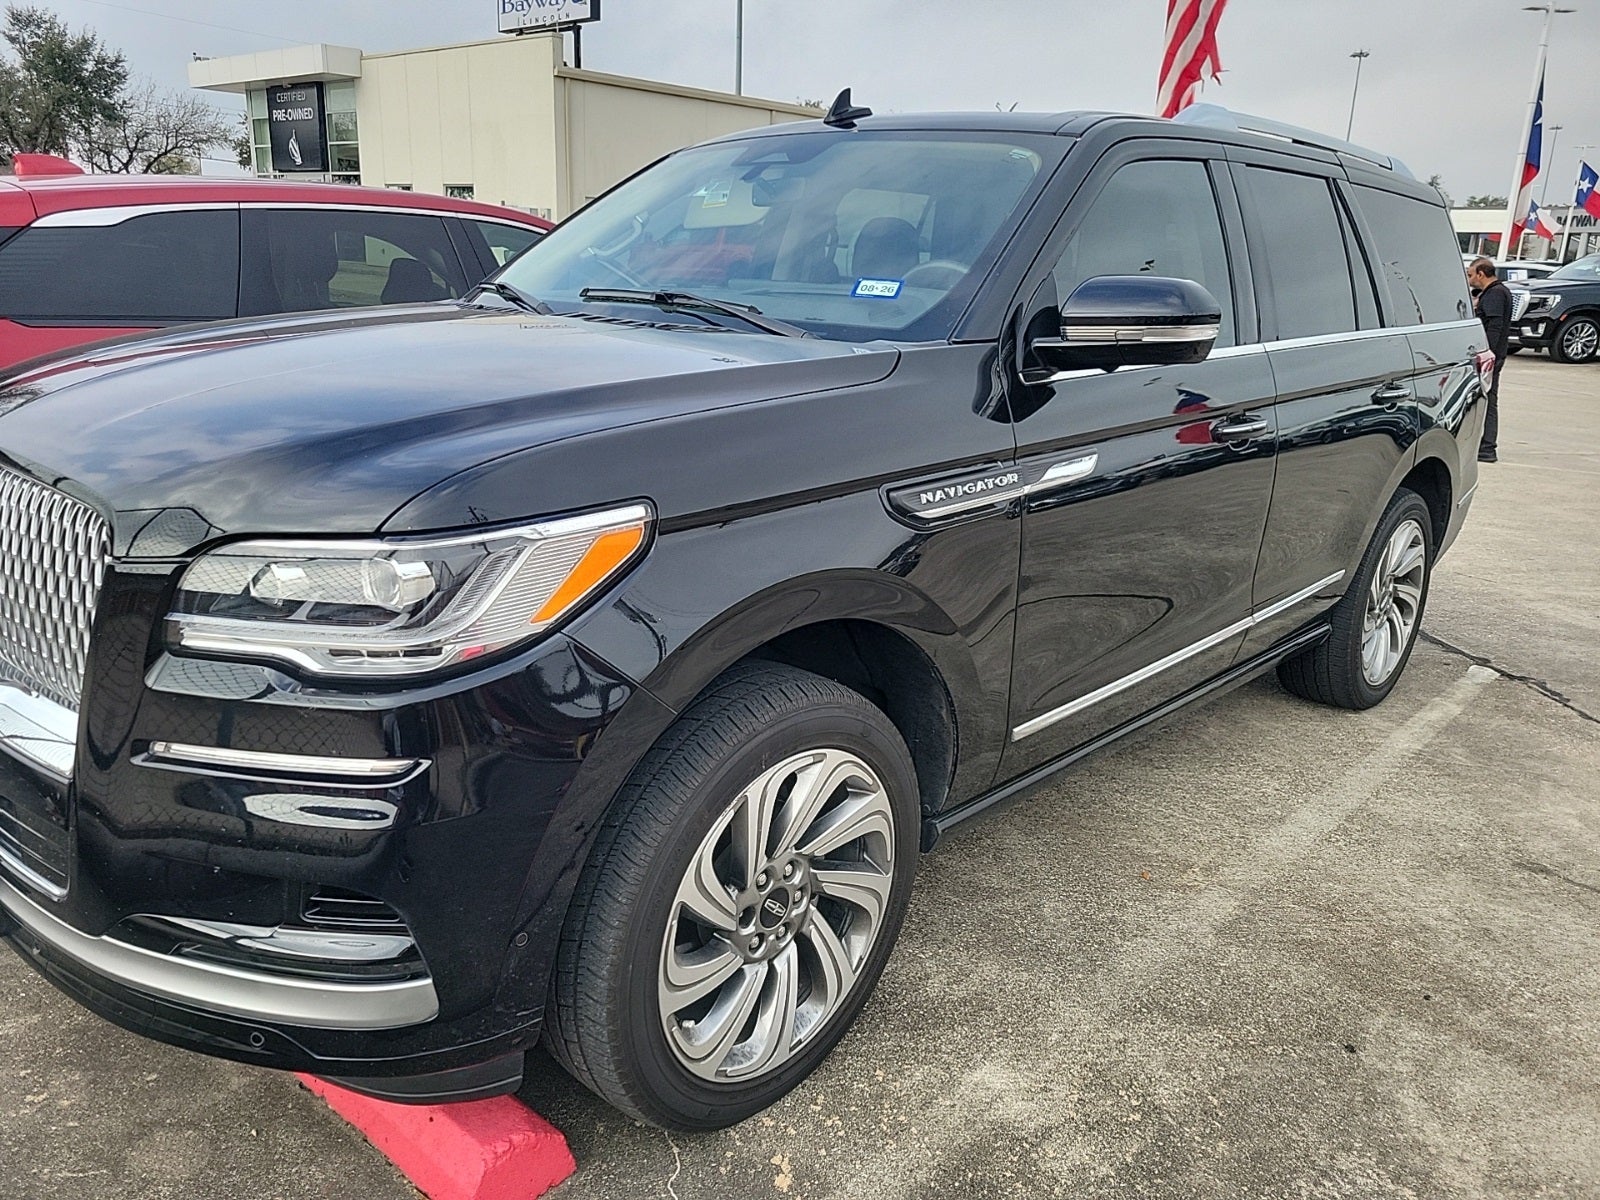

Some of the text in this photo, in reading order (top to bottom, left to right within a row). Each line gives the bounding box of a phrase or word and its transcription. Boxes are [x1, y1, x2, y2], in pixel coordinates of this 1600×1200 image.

[501, 0, 567, 17] Bayway
[522, 13, 570, 25] LINCOLN
[276, 91, 306, 103] CERTIFIED
[272, 107, 314, 122] PRE-OWNED
[920, 473, 1018, 505] NAVIGATOR
